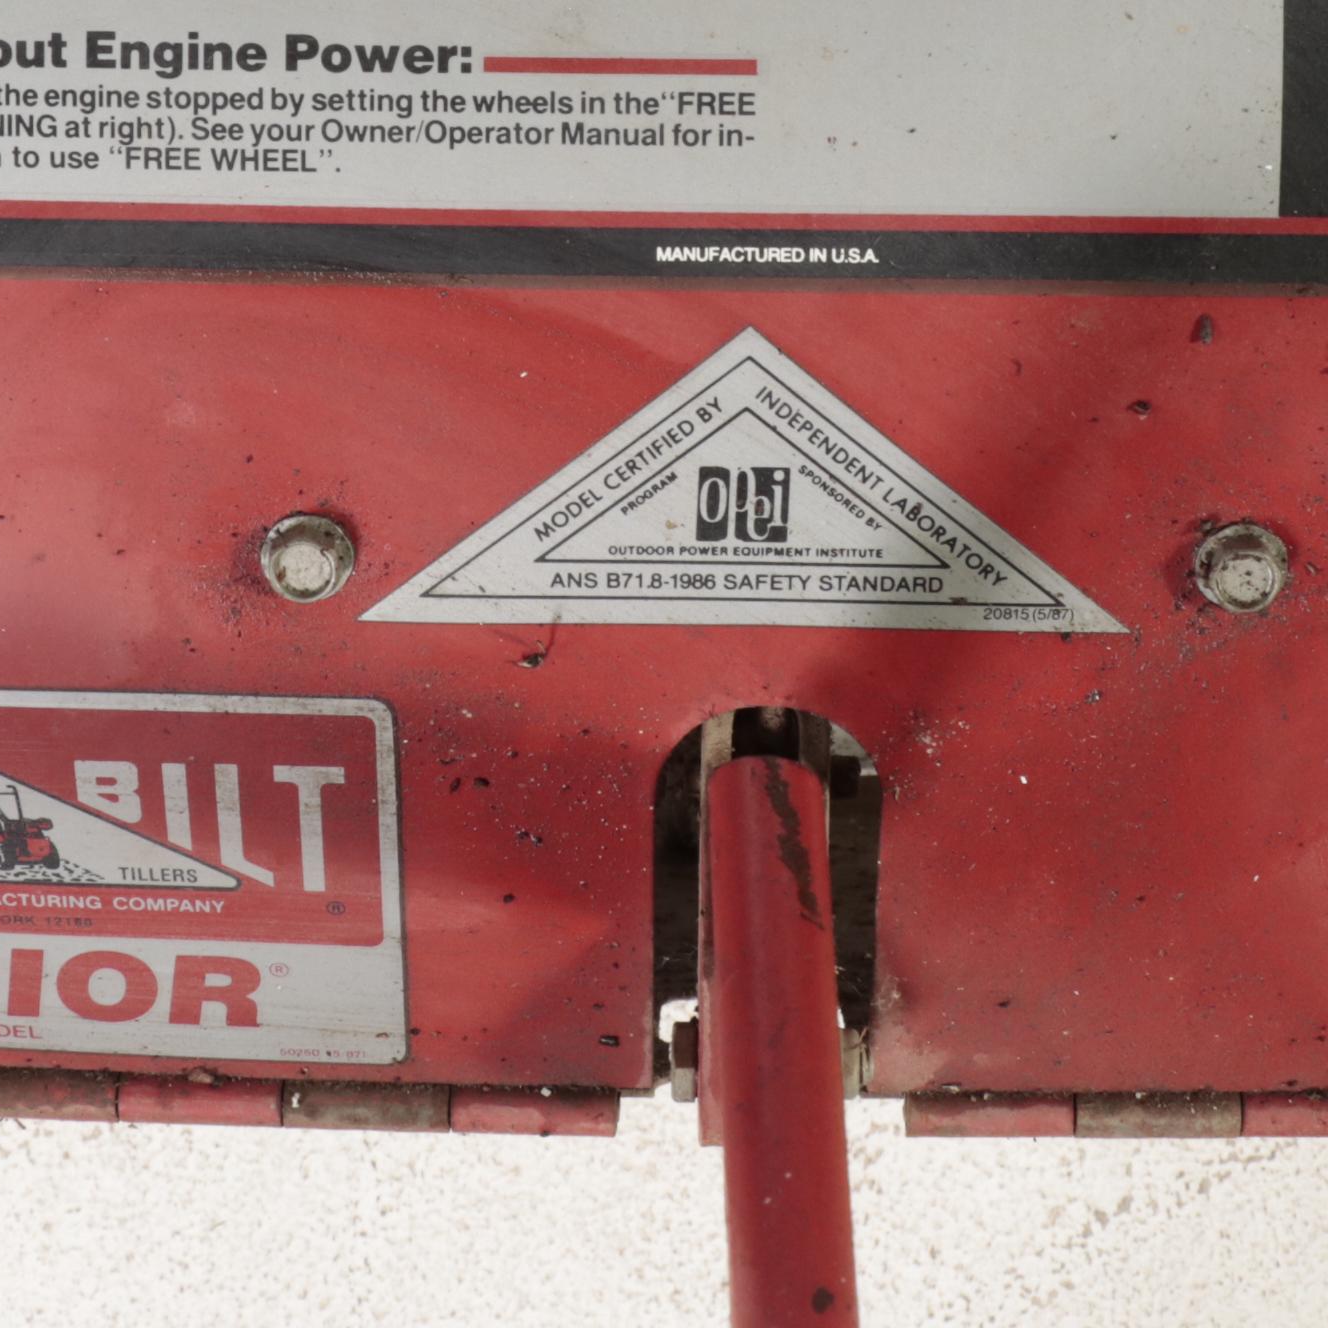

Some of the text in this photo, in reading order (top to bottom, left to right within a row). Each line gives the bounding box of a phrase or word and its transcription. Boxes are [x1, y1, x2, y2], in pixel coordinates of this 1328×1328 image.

[86, 31, 267, 77] Engine
[286, 34, 472, 74] Power:
[657, 247, 805, 262] MANUFACTURED
[810, 248, 827, 262] IN
[534, 397, 722, 541] MODEL CERTIFIED BY
[621, 472, 678, 515] PROGRAM
[755, 386, 1007, 586] INDEPENDENT LABORATORY
[798, 465, 882, 531] SPONSORED BY
[608, 546, 883, 558] OUTDOOR POWER EQUIPMENT INSTITUTE
[550, 573, 943, 593] ANS B71.8-1986 SAFETY STANDARD
[983, 608, 1074, 622] 20815 (5/87)
[74, 760, 346, 893] BILT
[118, 867, 197, 883] TILLERS
[113, 897, 224, 912] COMPANY
